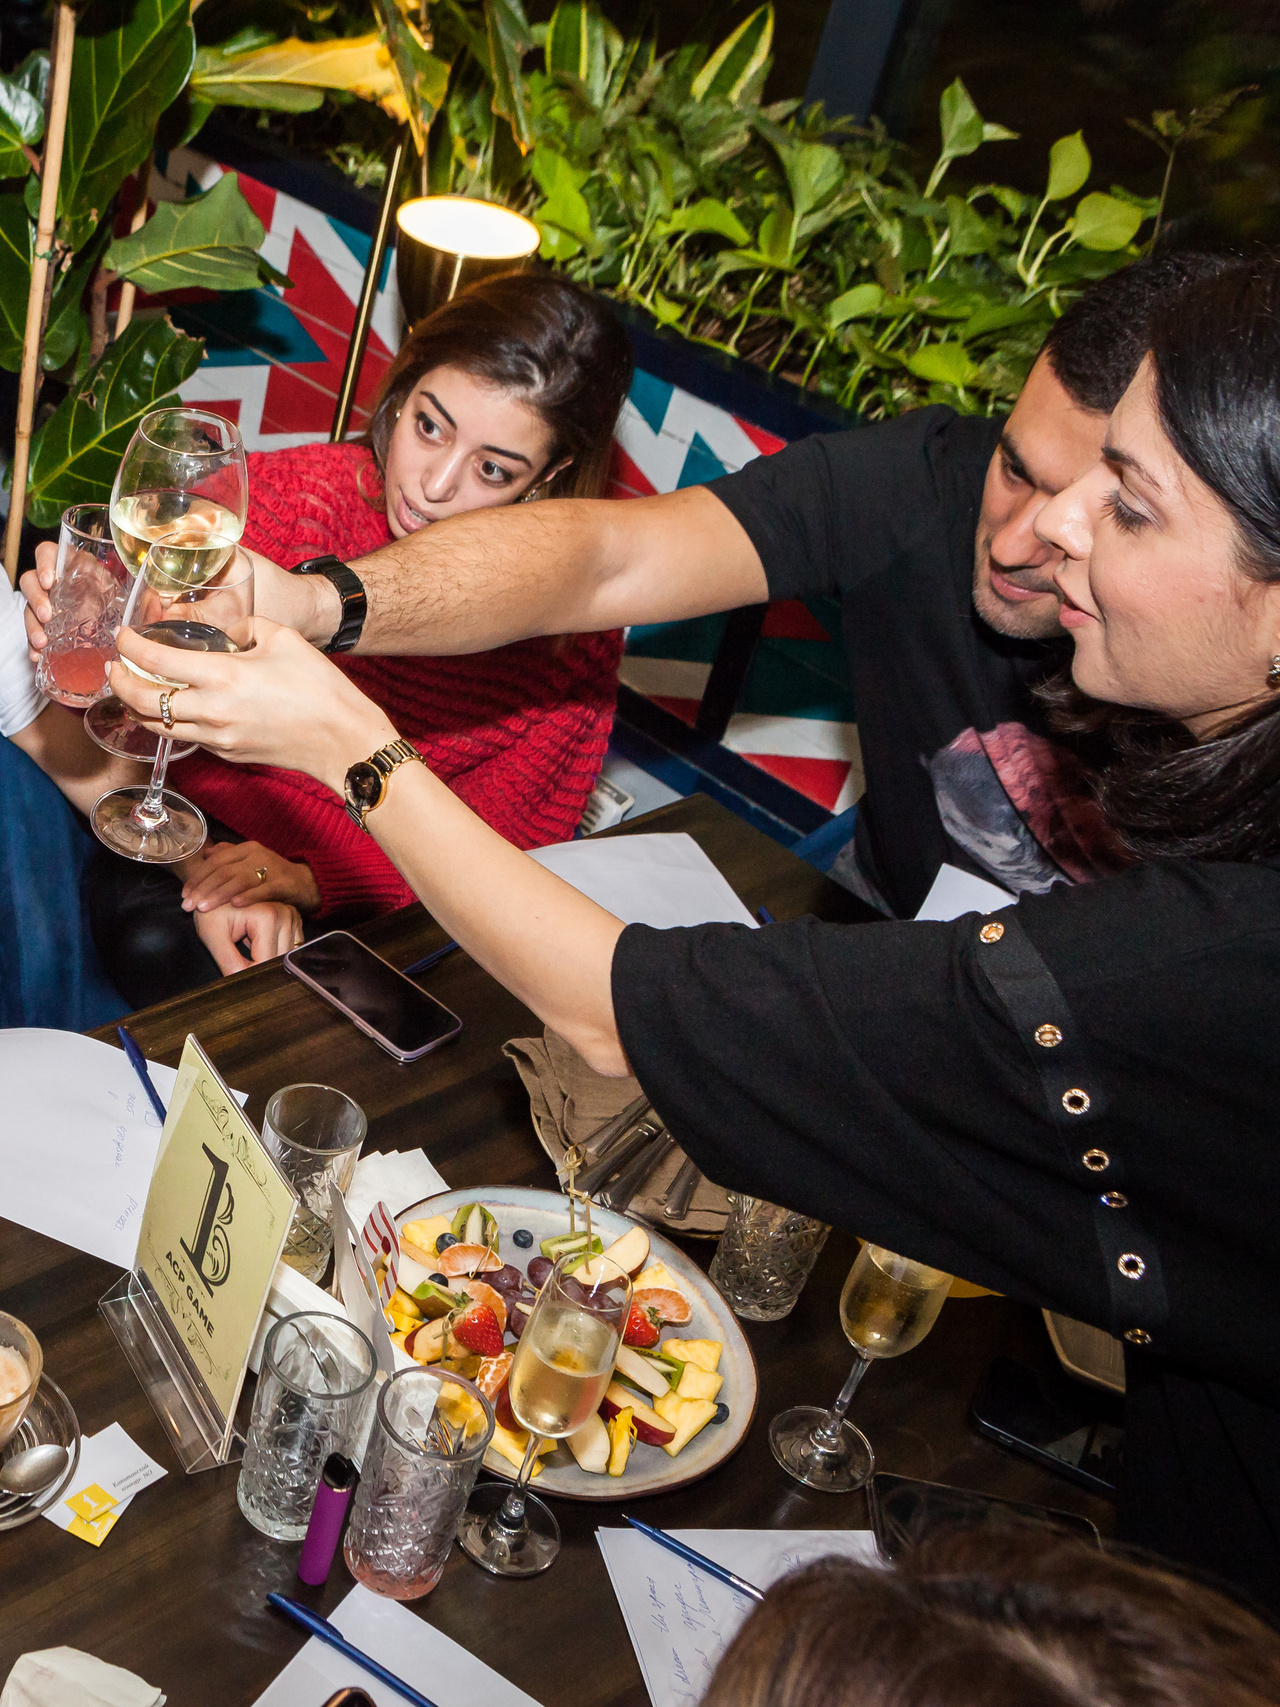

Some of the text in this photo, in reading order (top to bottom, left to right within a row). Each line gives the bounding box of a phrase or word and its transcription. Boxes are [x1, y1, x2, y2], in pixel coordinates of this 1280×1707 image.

[179, 1141, 235, 1299] 1
[165, 1250, 185, 1283] ACP
[186, 1285, 215, 1339] GAME
